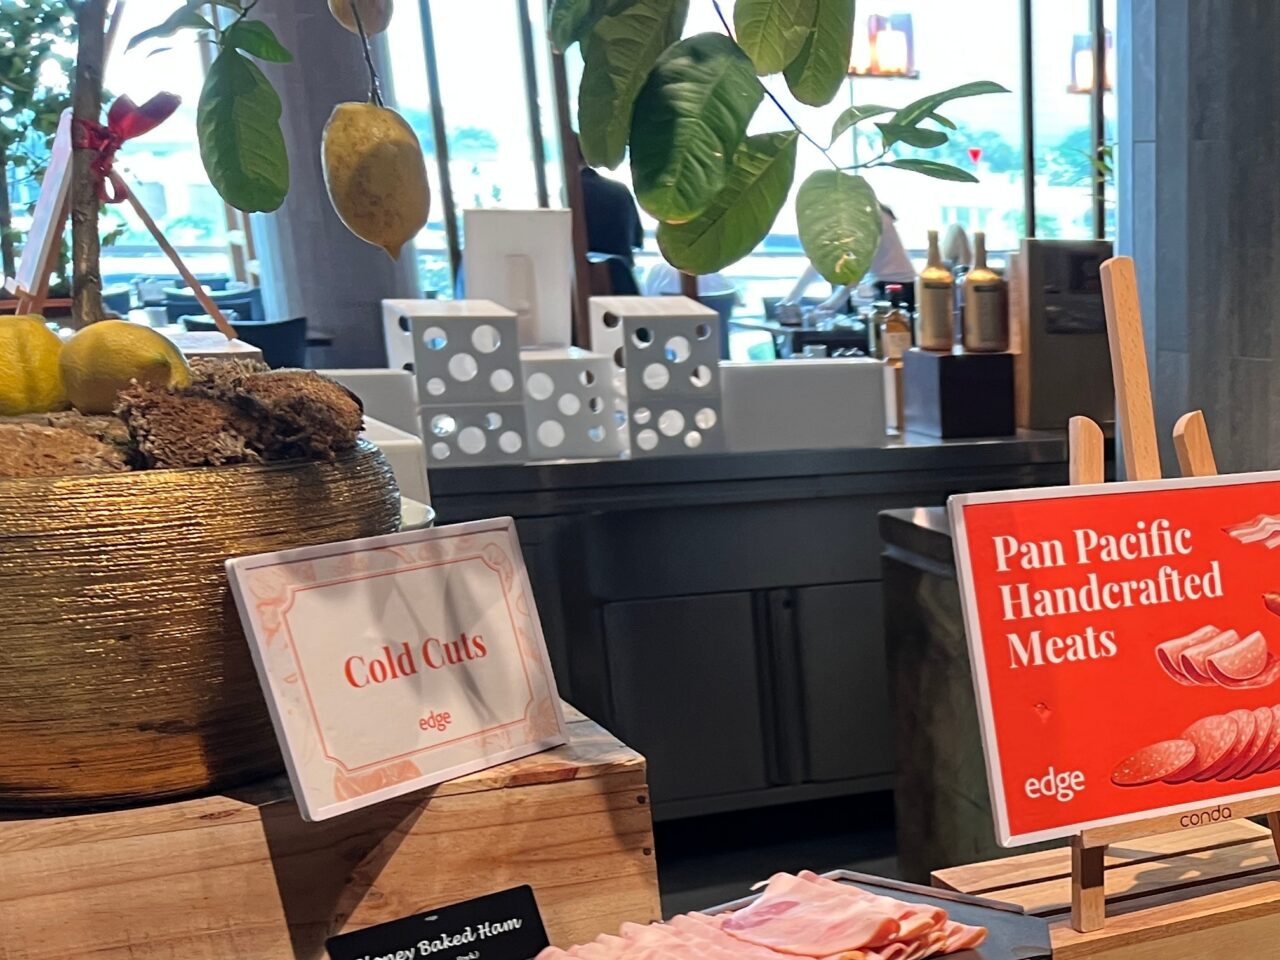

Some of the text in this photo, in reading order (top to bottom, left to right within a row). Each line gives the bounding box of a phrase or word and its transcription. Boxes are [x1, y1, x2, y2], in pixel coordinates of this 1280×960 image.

[992, 518, 1193, 572] Pan Pacific
[998, 561, 1224, 621] Handcrafted
[343, 633, 488, 689] Cold Cuts
[1006, 626, 1118, 669] Meats
[418, 710, 452, 731] edge
[1024, 766, 1086, 802] edge
[1179, 804, 1232, 828] conda
[416, 926, 477, 956] Baked
[476, 918, 523, 940] Ham
